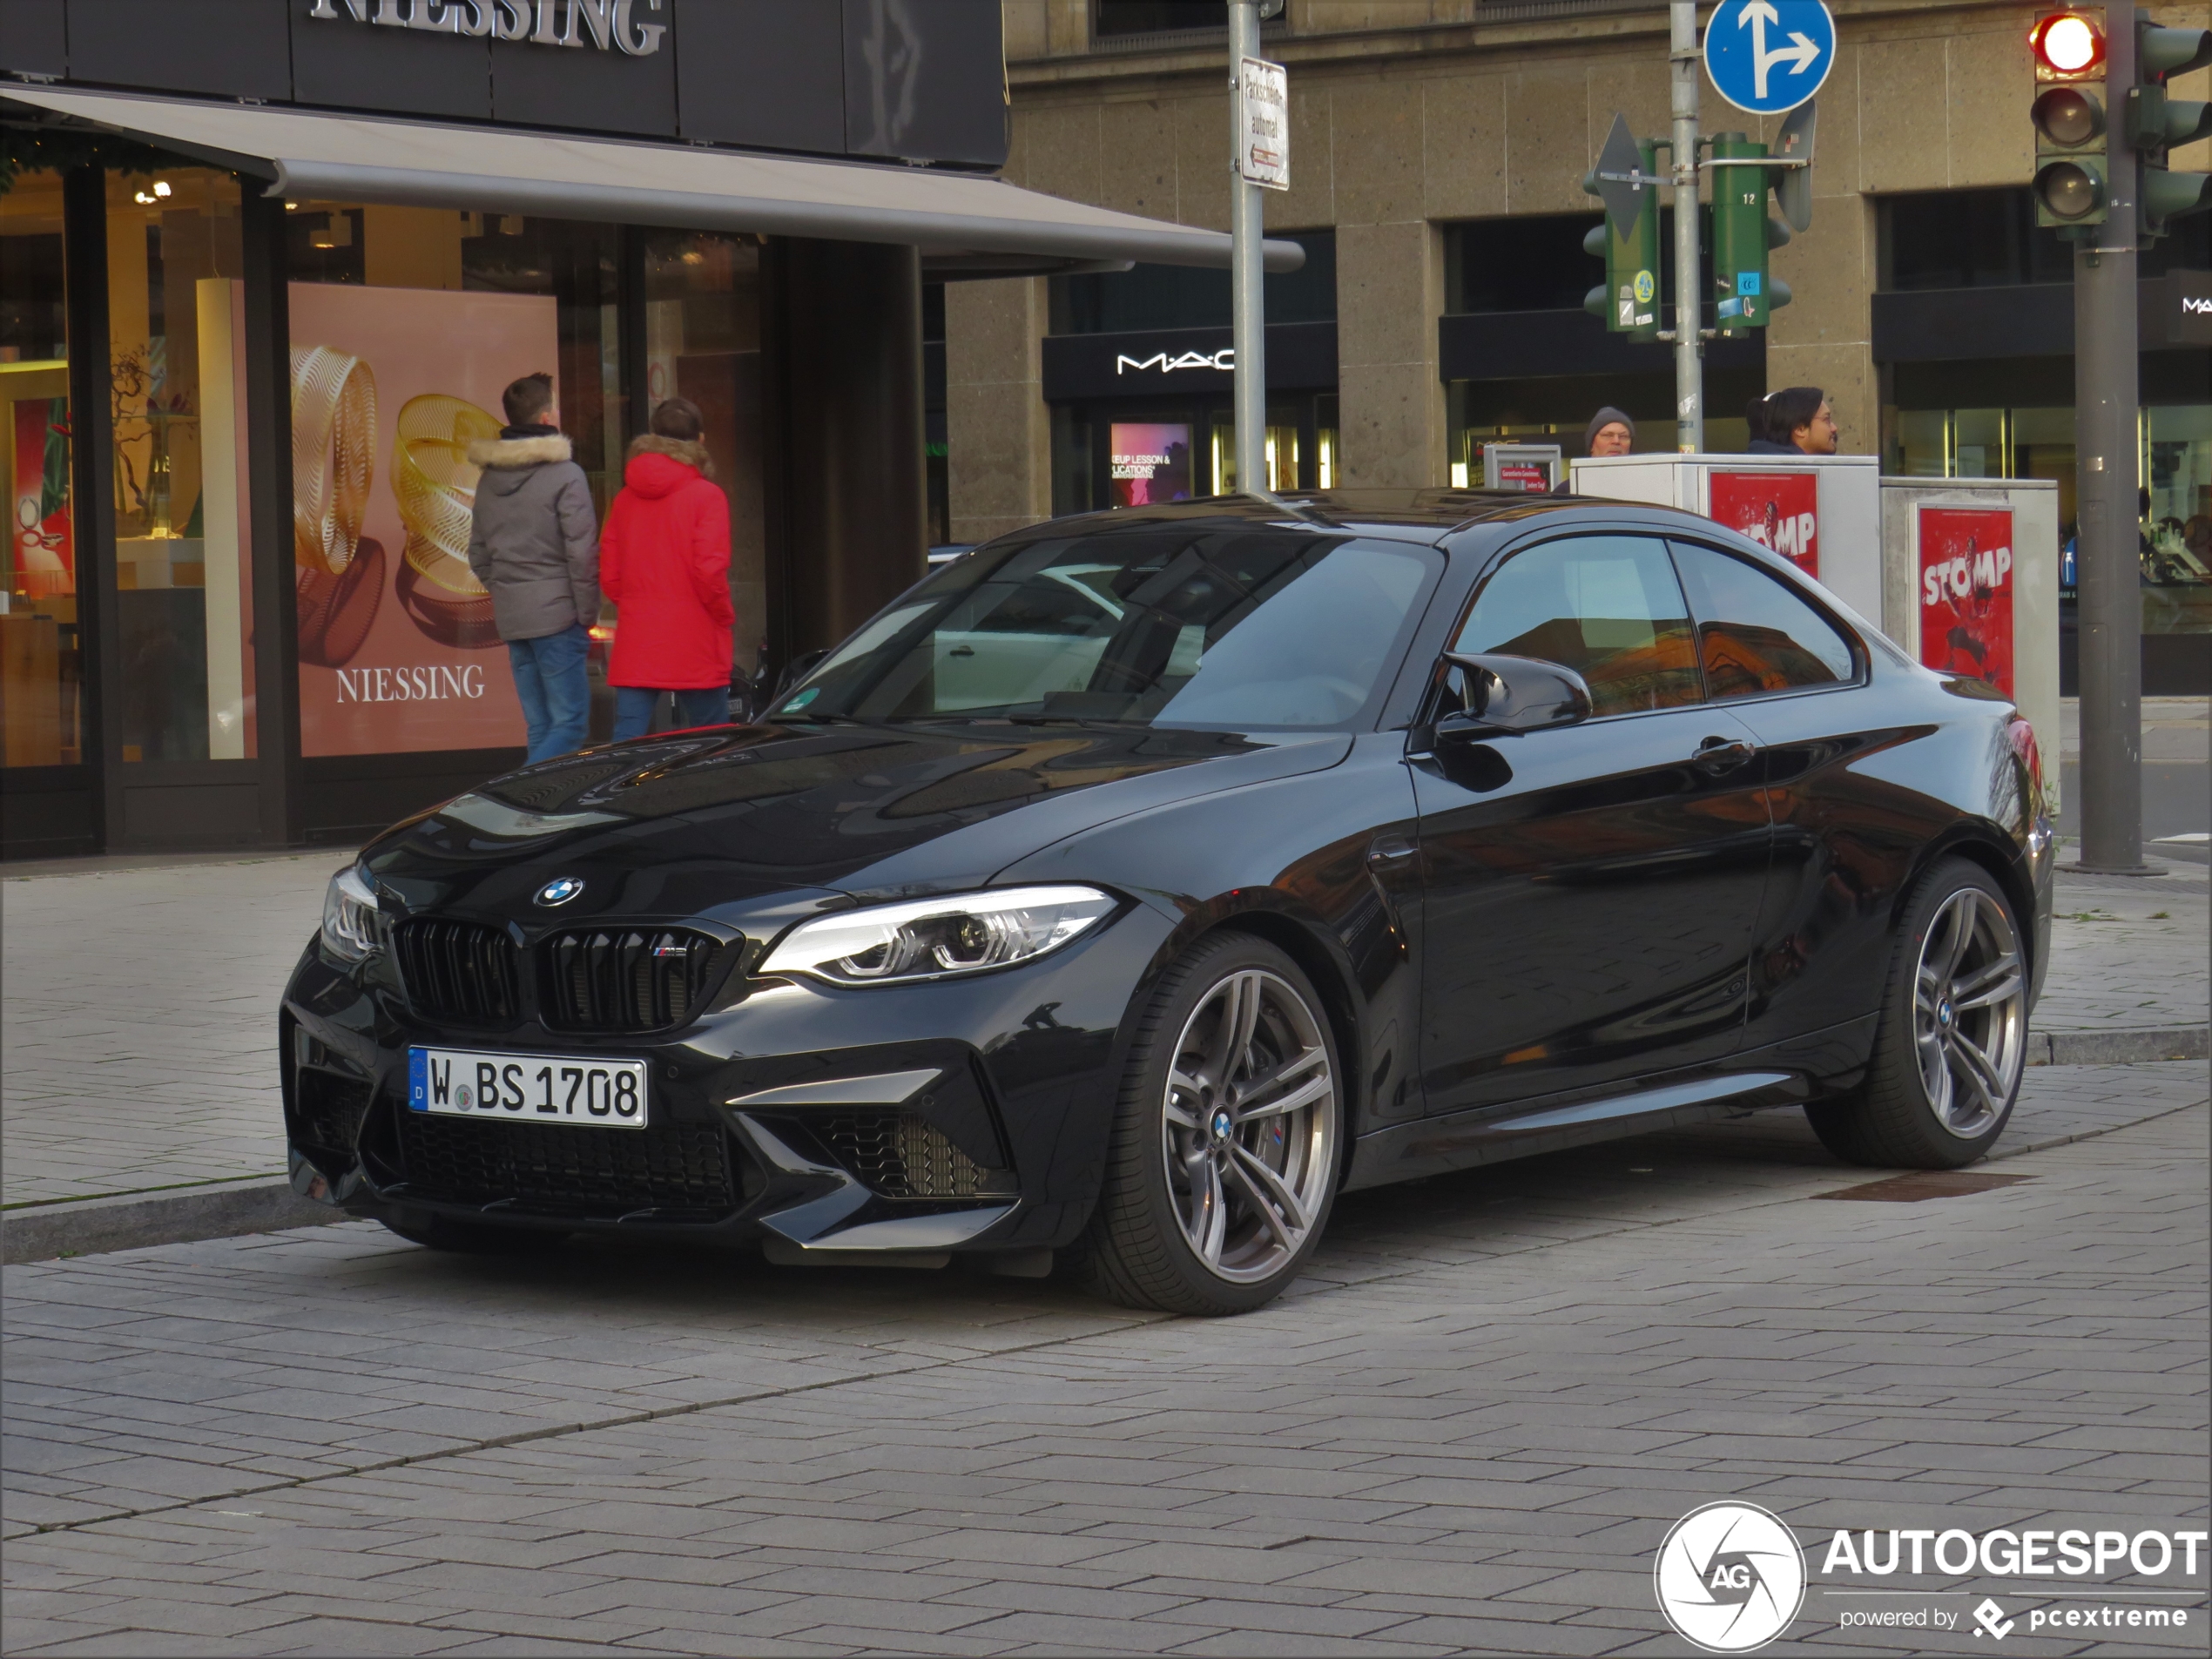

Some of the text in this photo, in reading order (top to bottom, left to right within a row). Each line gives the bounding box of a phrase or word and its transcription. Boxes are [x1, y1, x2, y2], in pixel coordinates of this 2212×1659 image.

[1245, 72, 1283, 106] Parkschein-
[1251, 112, 1278, 139] automat
[1743, 193, 1756, 205] 12
[1111, 465, 1156, 475] LICATIONS
[1131, 455, 1163, 464] LESSON
[1163, 455, 1170, 464] &
[1924, 547, 2011, 606] STOMP
[336, 664, 485, 703] NIESSING
[415, 1058, 638, 1117] D W BS 1708
